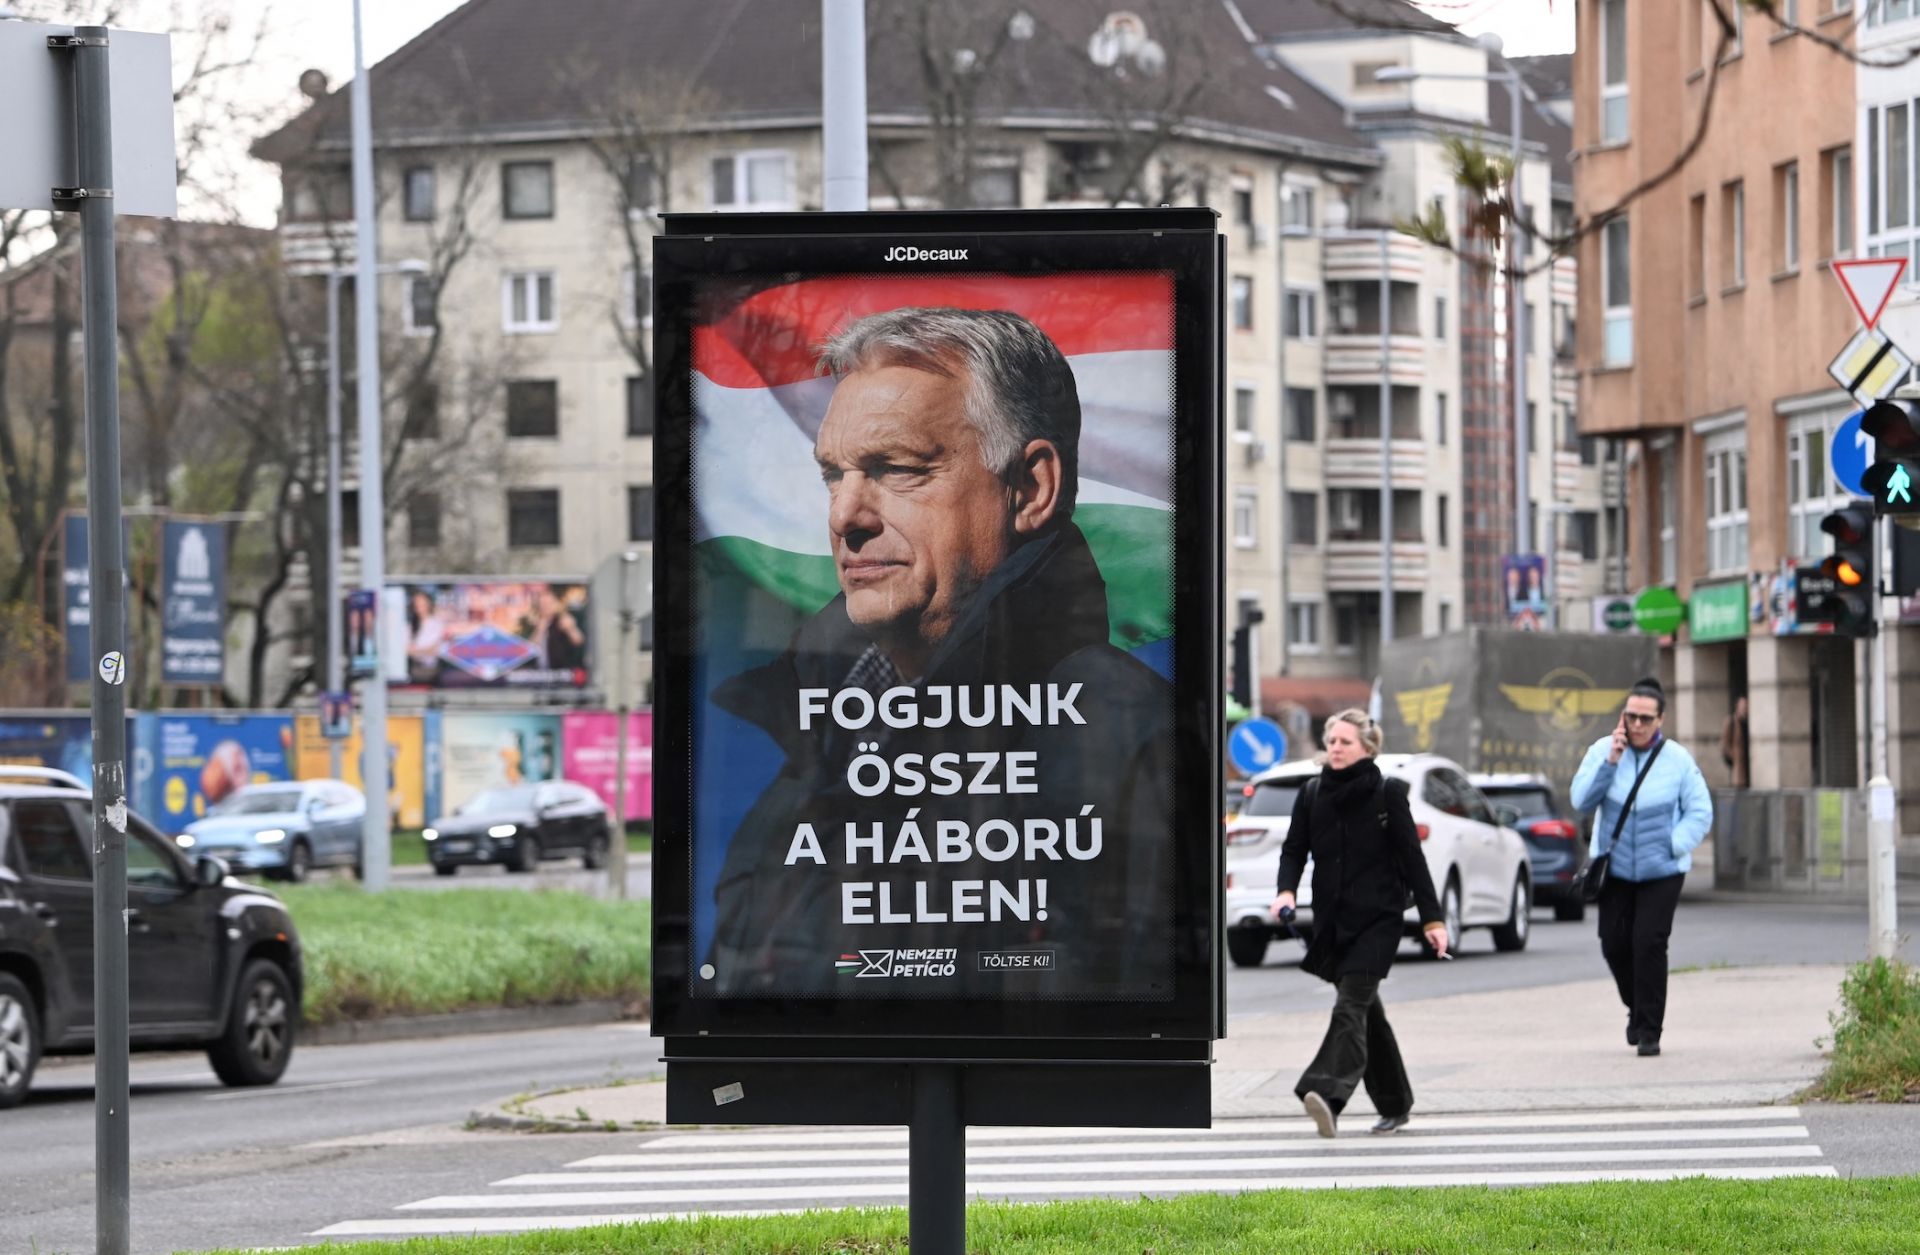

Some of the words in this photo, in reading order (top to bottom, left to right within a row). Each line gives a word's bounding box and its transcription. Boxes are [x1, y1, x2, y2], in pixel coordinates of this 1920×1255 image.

[885, 246, 968, 262] JCDecaux
[798, 683, 1087, 730] FOGJUNK
[847, 742, 1038, 797] ÖSSZE
[784, 823, 827, 865] A
[845, 805, 1103, 864] HÁBORÚ
[842, 879, 1048, 924] ELLEN!
[893, 960, 956, 977] PETÍCIÓ
[896, 948, 958, 960] NEMZETI
[983, 953, 1030, 968] TÖLTSE
[1033, 955, 1050, 967] KI!
